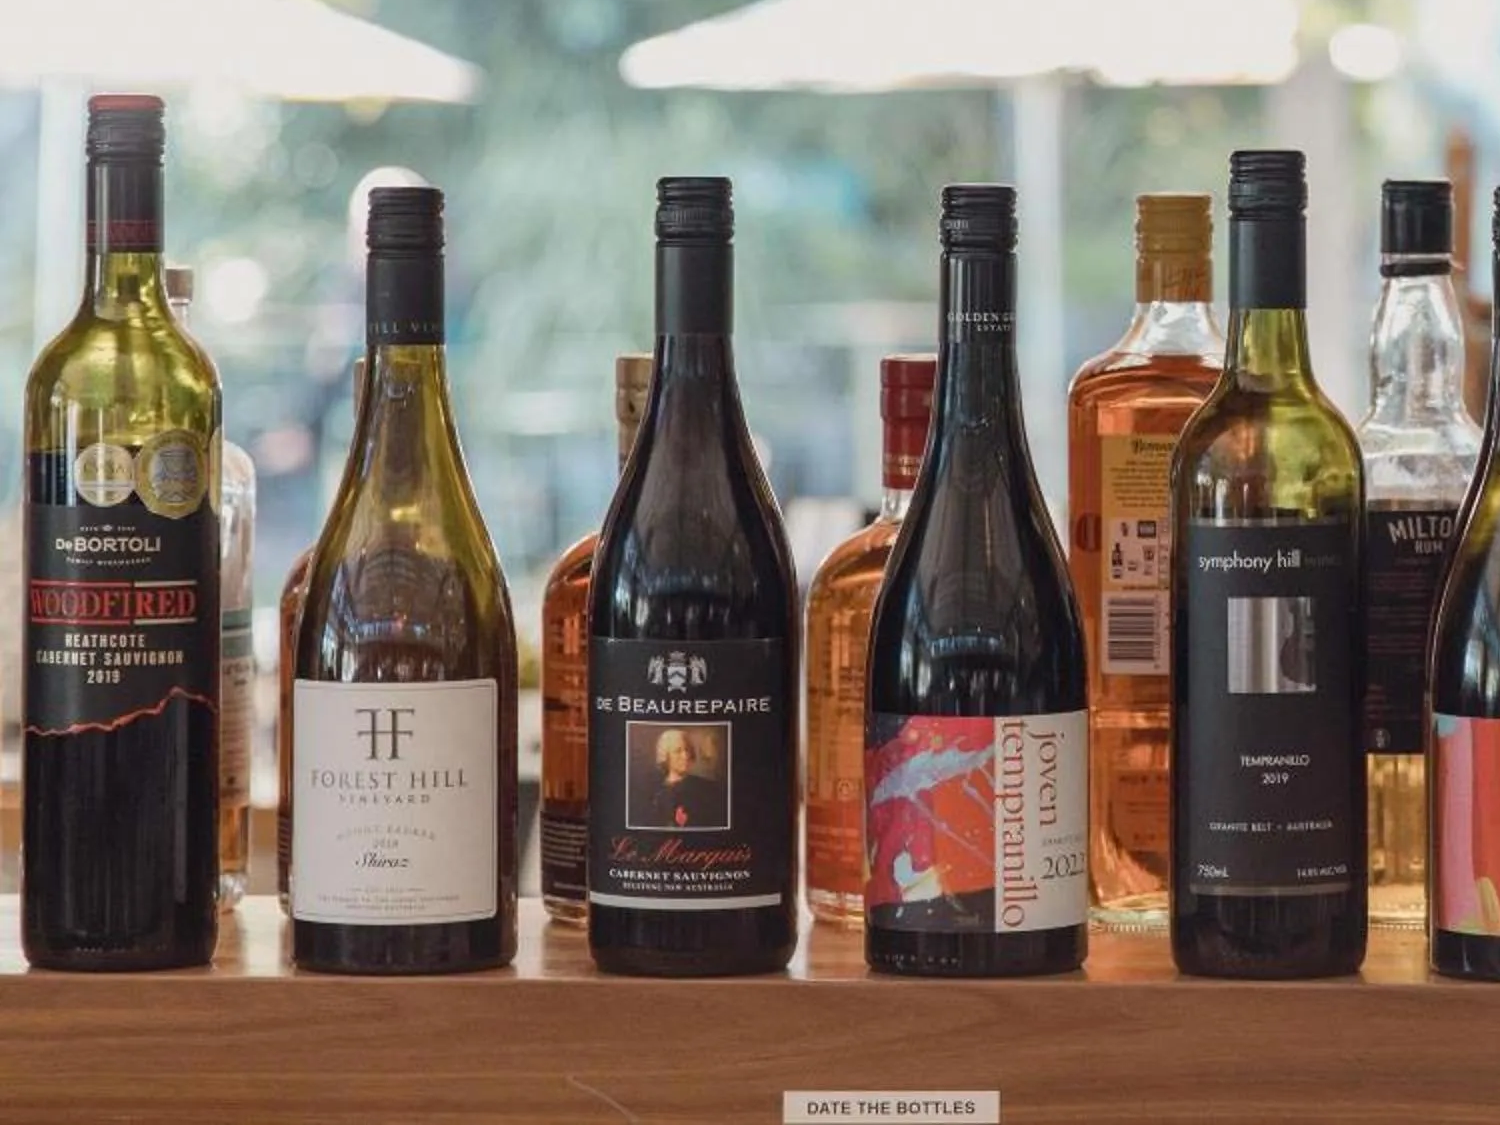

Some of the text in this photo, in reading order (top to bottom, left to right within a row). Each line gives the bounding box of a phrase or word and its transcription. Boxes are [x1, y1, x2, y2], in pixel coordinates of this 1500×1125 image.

[1387, 516, 1452, 545] MILTO
[1198, 549, 1273, 574] symphony
[1277, 548, 1301, 568] hill
[31, 586, 197, 619] WOODFIRED
[64, 632, 146, 649] HEATHCOTE
[36, 649, 185, 666] CABERNET SAUVIGNON
[86, 669, 121, 685] 2019
[597, 695, 772, 715] DE BEAUREPAIRE
[1240, 754, 1310, 767] TEMPRANILLO
[311, 767, 469, 790] FOREST HILL
[1027, 721, 1066, 827] joven
[1262, 772, 1290, 785] 2019
[339, 793, 431, 804] VINEYARD
[996, 720, 1038, 928] tempranillo
[355, 851, 409, 869] Shiraz
[641, 834, 752, 872] Marquis
[608, 868, 752, 881] CABERNET SAUVIGNON
[807, 1101, 976, 1116] DATE THE BOTTLES
